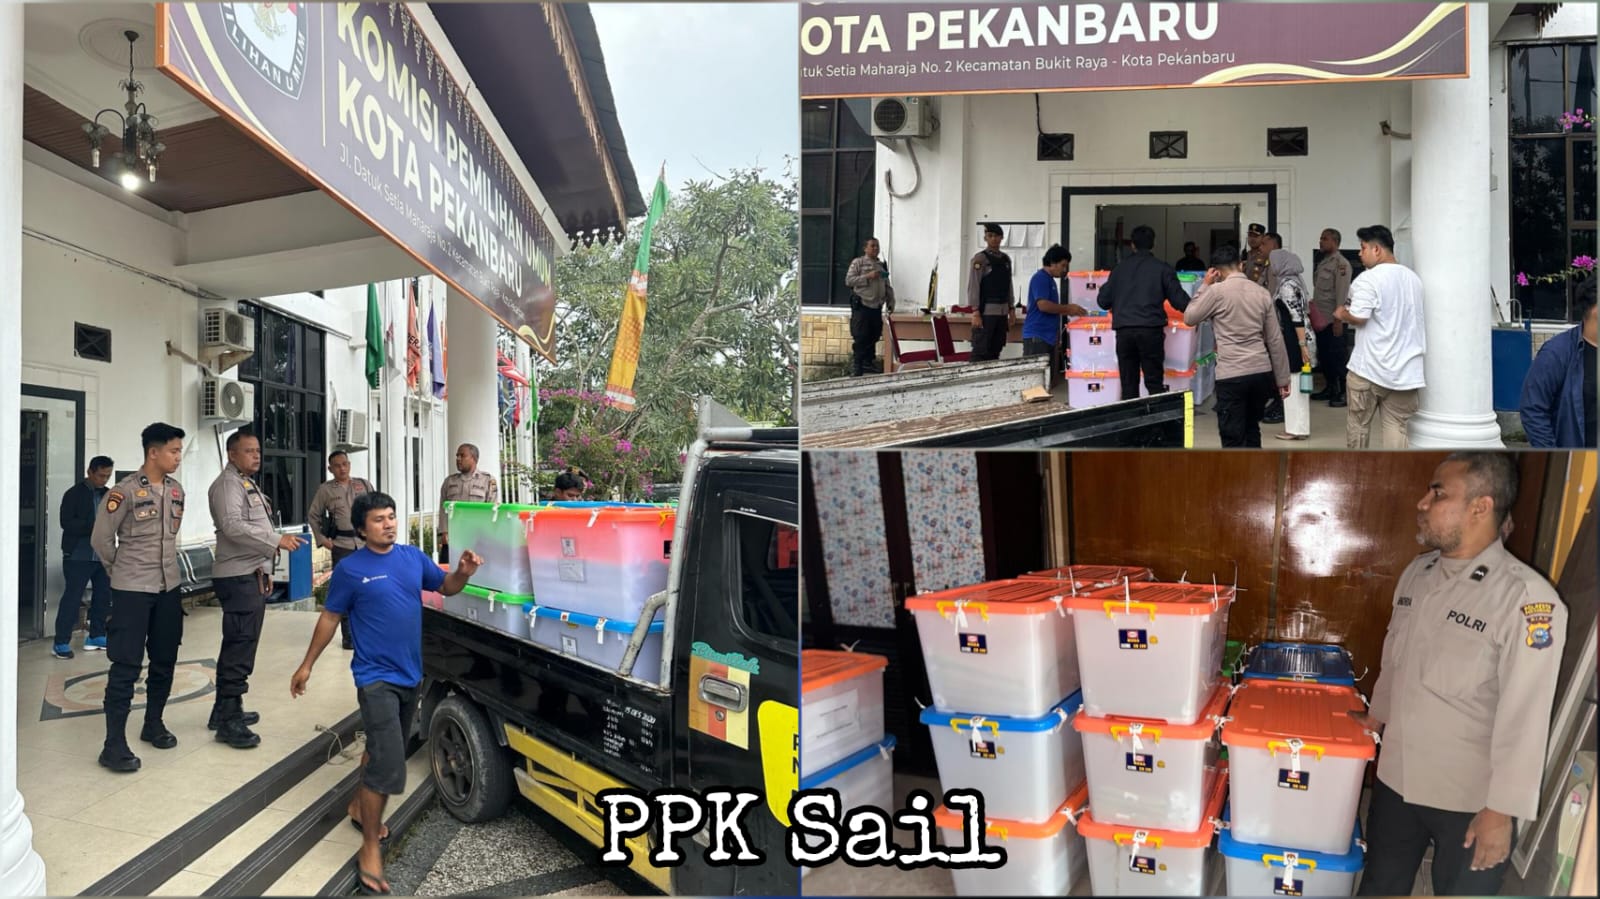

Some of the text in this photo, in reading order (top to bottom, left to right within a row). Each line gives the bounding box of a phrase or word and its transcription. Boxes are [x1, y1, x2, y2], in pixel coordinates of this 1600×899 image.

[907, 2, 1219, 52] PEKANBARU
[826, 63, 857, 77] Setia
[860, 62, 917, 77] Maharaja
[921, 61, 941, 74] No.
[944, 60, 953, 73] 2
[956, 58, 1031, 73] Kecamatan
[1035, 55, 1072, 71] Bukit
[1076, 56, 1108, 73] Raya
[1121, 54, 1153, 67] Kota
[1157, 51, 1236, 66] Pekanbaru
[337, 3, 552, 291] KOMISI PEMILIHAN UMUM
[340, 142, 353, 169] Jl.
[354, 154, 383, 195] Datuk
[338, 59, 523, 298] KOTA PEKANBARU
[1446, 609, 1487, 632] POLRI
